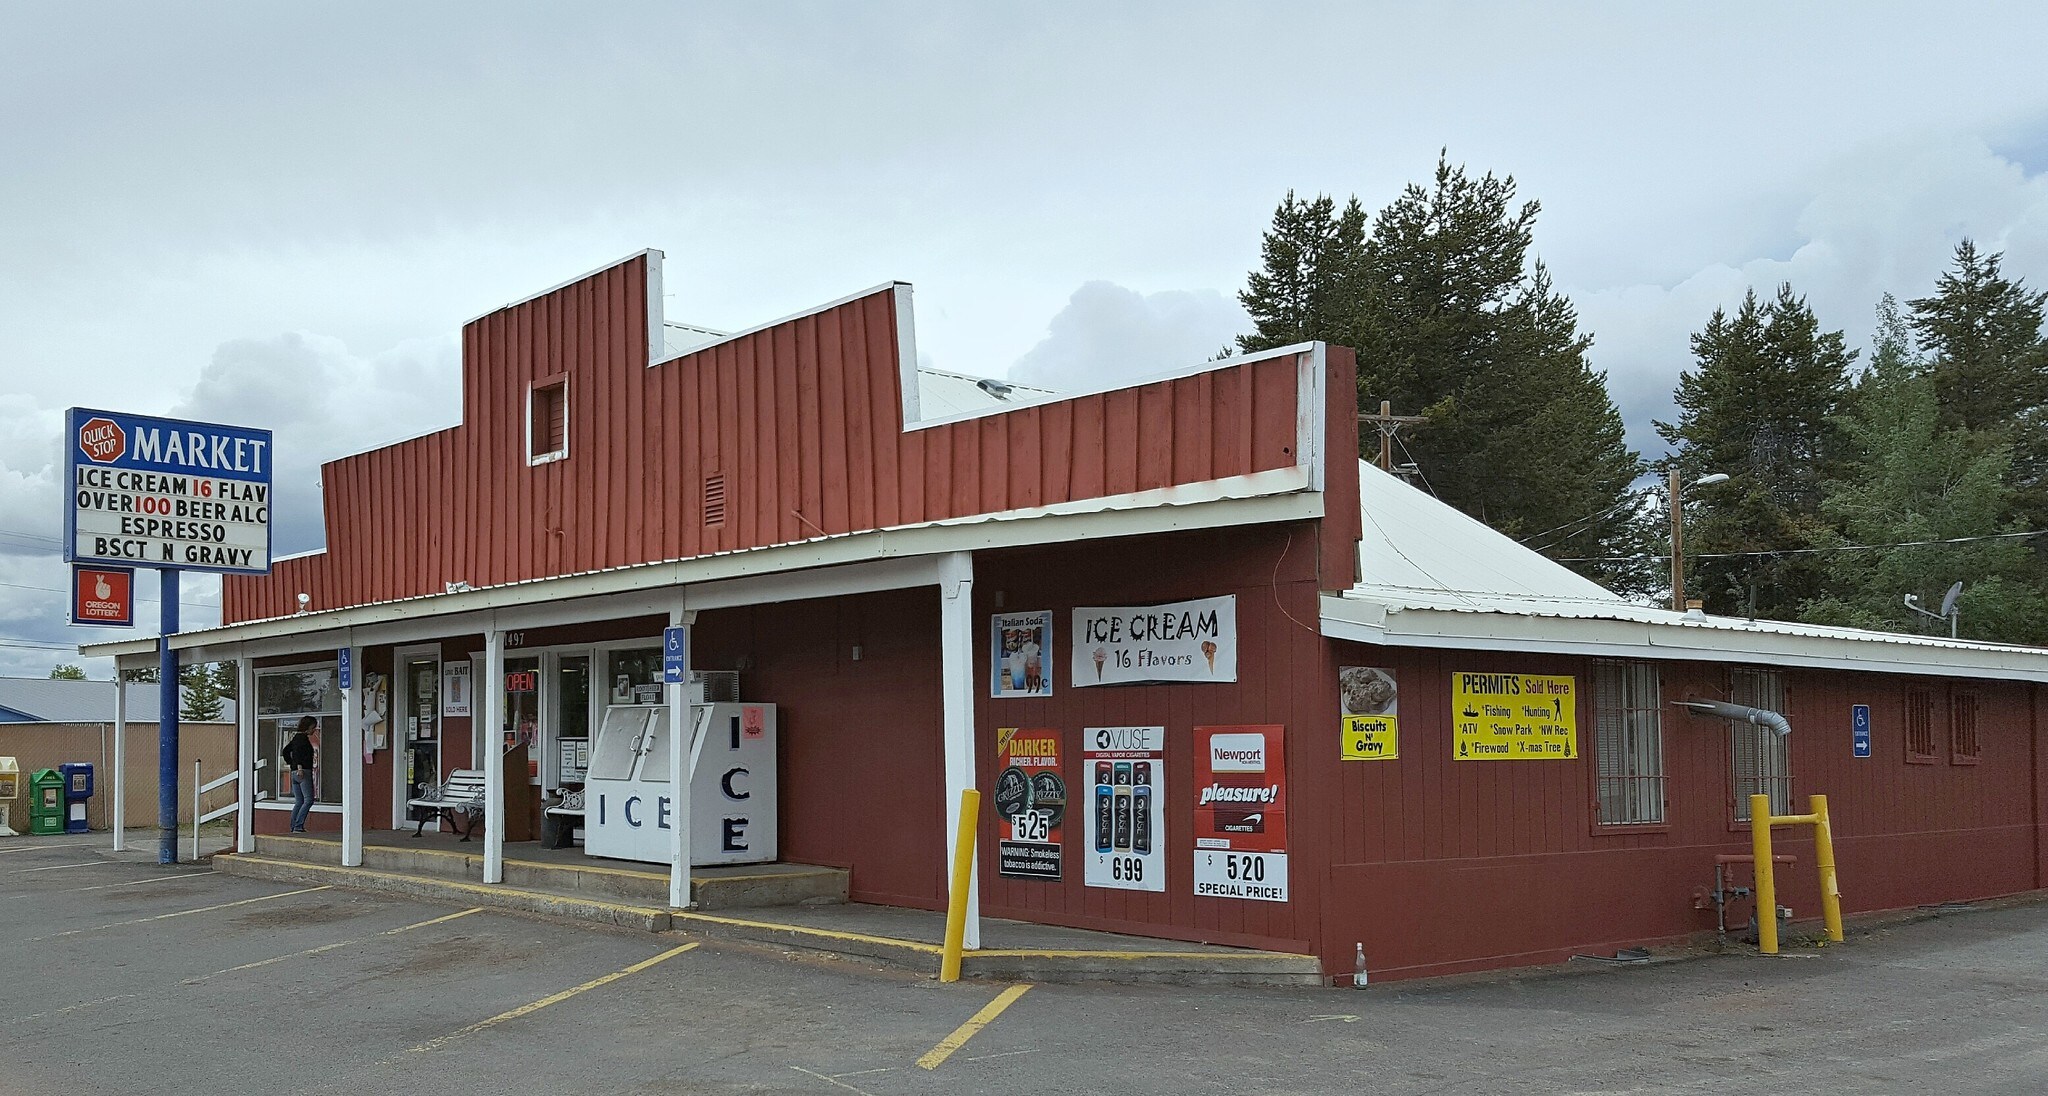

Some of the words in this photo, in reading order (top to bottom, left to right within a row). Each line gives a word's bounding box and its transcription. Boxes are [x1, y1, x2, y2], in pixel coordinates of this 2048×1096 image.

[83, 424, 115, 445] QUICK
[93, 438, 117, 458] STOP
[132, 426, 266, 474] MARKET
[78, 468, 112, 488] ICE
[117, 472, 187, 495] CREAM
[193, 479, 212, 497] 16
[219, 482, 267, 502] FLAV
[77, 491, 133, 513] OVER
[135, 496, 171, 515] 100
[176, 500, 226, 521] BEER
[231, 505, 267, 524] ALC
[121, 516, 226, 543] ESPRESSO
[95, 537, 147, 558] BSCT
[163, 543, 174, 561] N
[185, 545, 253, 566] GRAVY
[85, 601, 121, 609] OREGON
[1002, 618, 1024, 627] Italian
[1025, 617, 1043, 626] Soda
[1086, 616, 1123, 644] ICE
[1129, 609, 1218, 642] CREAM
[1114, 649, 1132, 668] 16
[1138, 648, 1193, 667] Flavors
[454, 666, 469, 676] BAIT
[507, 672, 534, 691] OPEN
[1462, 674, 1520, 695] PERMITS
[1525, 679, 1543, 694] Sold
[1547, 680, 1569, 694] Here
[1352, 719, 1387, 732] Biscuits
[1515, 724, 1533, 735] Park
[1555, 725, 1568, 735] Rec
[1110, 729, 1150, 749] VUSE
[1356, 740, 1383, 755] Gravy
[1544, 741, 1561, 752] Tree
[1214, 748, 1261, 762] Newport
[998, 781, 1025, 802] GRIZZLY
[1036, 790, 1061, 801] RIZZLY
[1199, 783, 1278, 806] pleasure!
[1030, 848, 1060, 859] Smokeless
[1004, 859, 1025, 869] tobacco
[1025, 860, 1030, 869] is
[1198, 883, 1243, 897] SPECIAL
[1246, 885, 1283, 899] PRICE!
